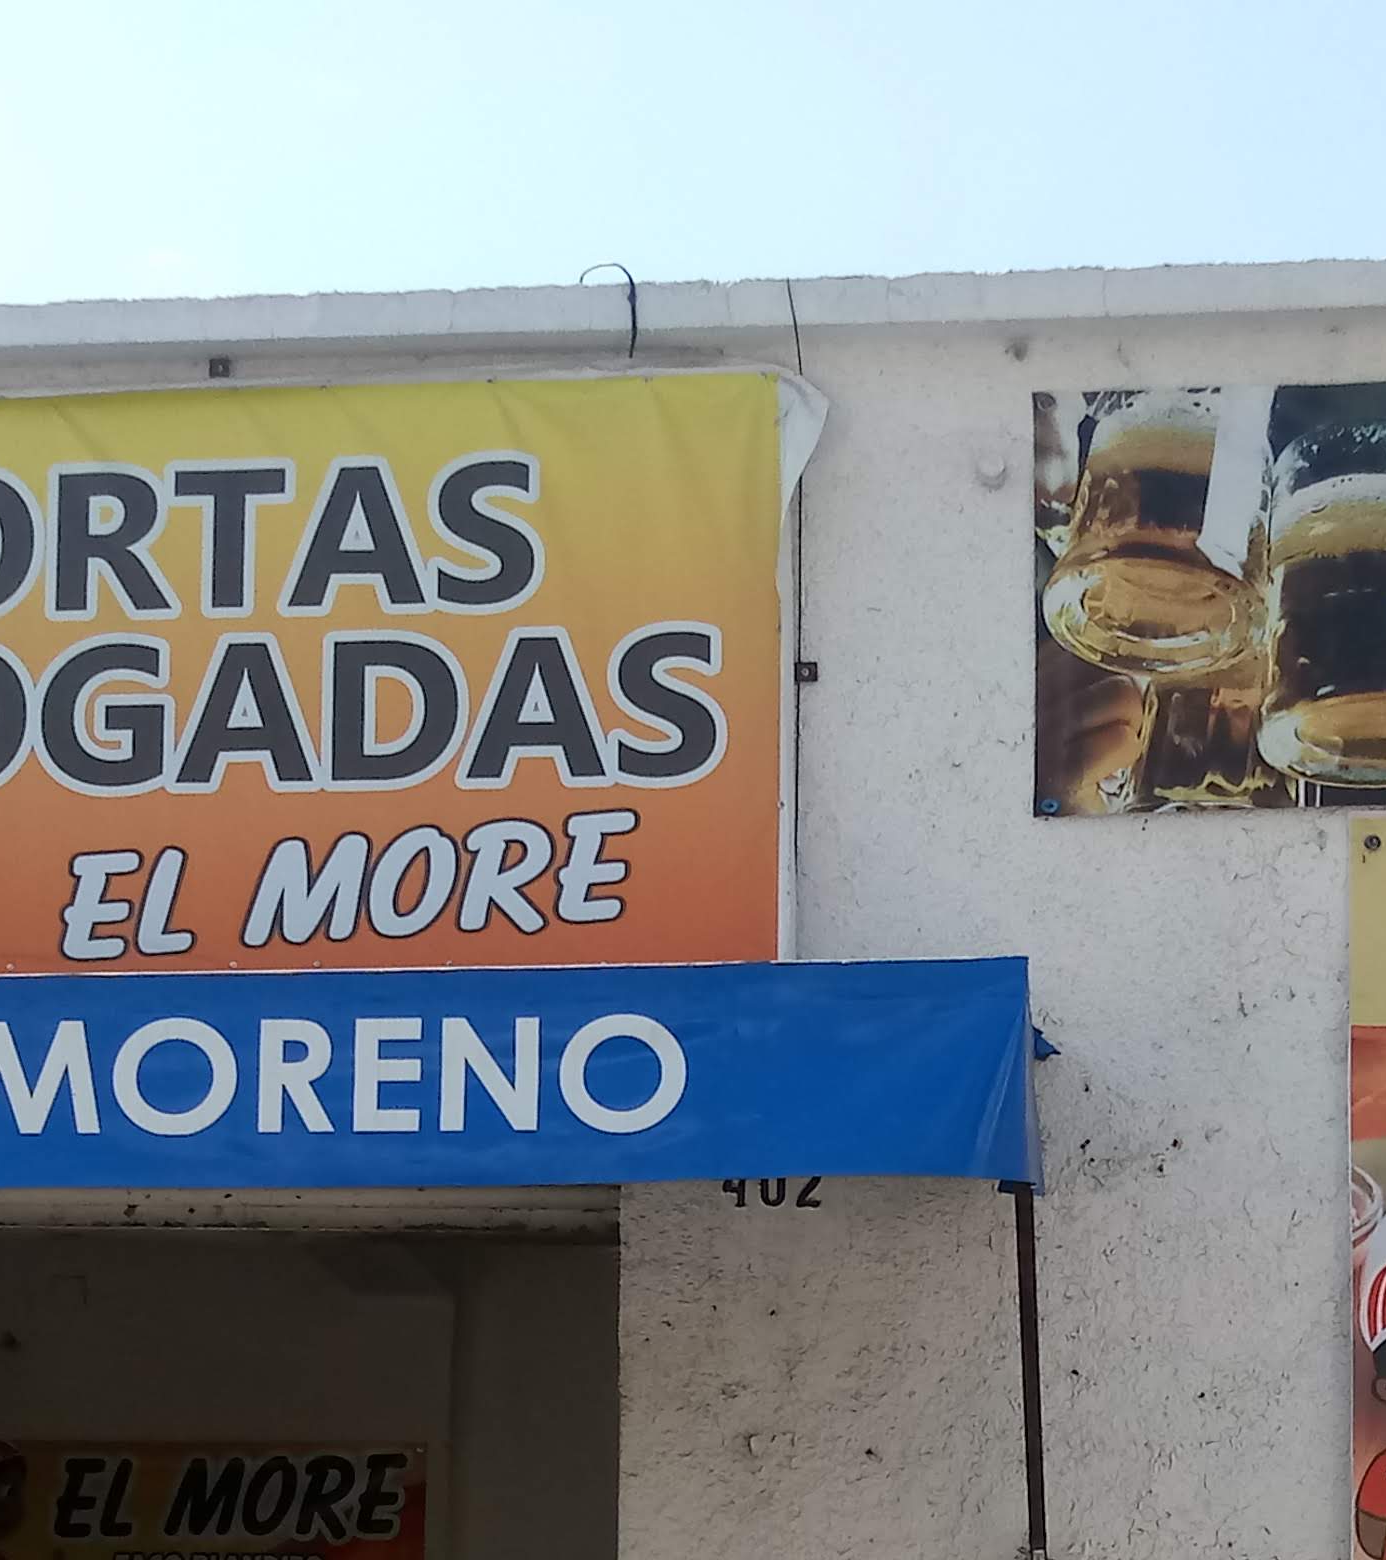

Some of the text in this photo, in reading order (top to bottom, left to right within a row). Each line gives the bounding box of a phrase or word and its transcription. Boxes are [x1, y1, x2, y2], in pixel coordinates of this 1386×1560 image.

[61, 809, 641, 962] EL MORE
[54, 1453, 408, 1541] EL MORE
